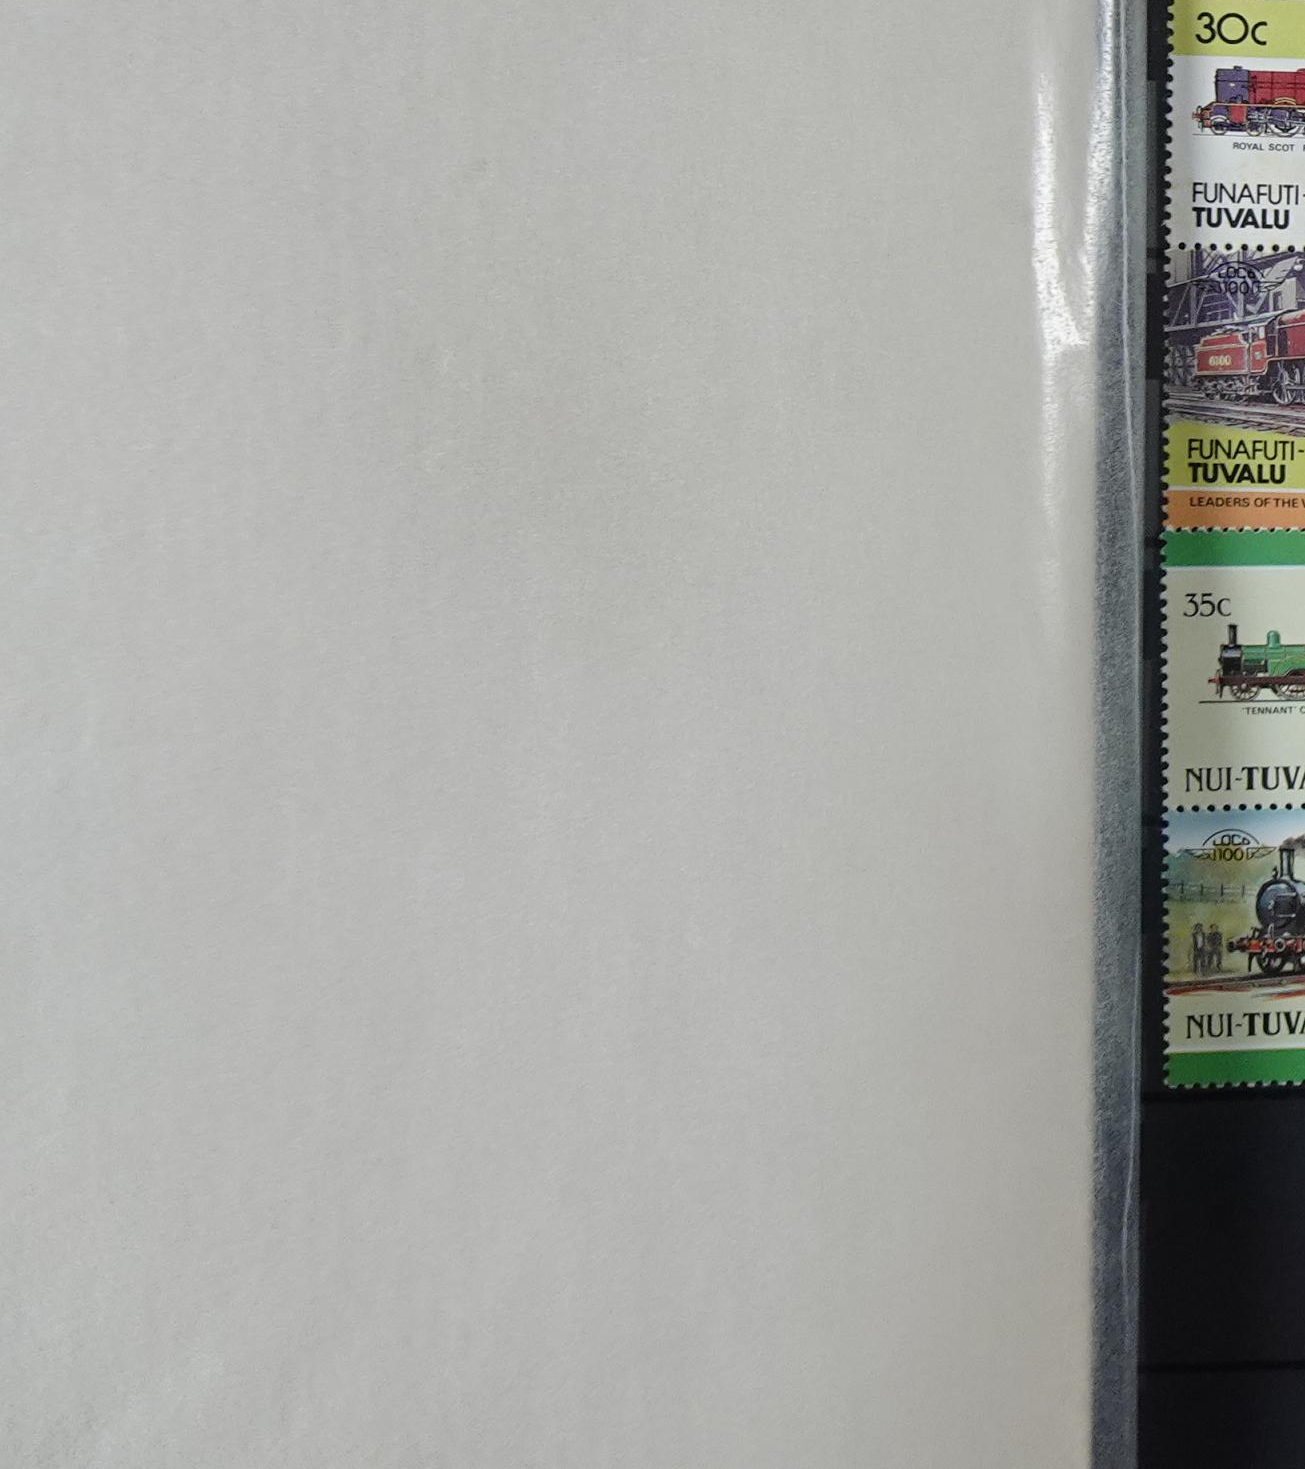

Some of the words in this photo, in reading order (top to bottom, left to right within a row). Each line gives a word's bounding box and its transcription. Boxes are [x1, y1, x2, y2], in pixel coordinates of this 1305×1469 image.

[1196, 12, 1268, 46] 30c
[1233, 142, 1264, 152] ROYAL
[1268, 143, 1295, 153] SCOT
[1192, 207, 1290, 230] TUVALU
[1187, 463, 1287, 485] TUVALU
[1183, 593, 1232, 618] 35c
